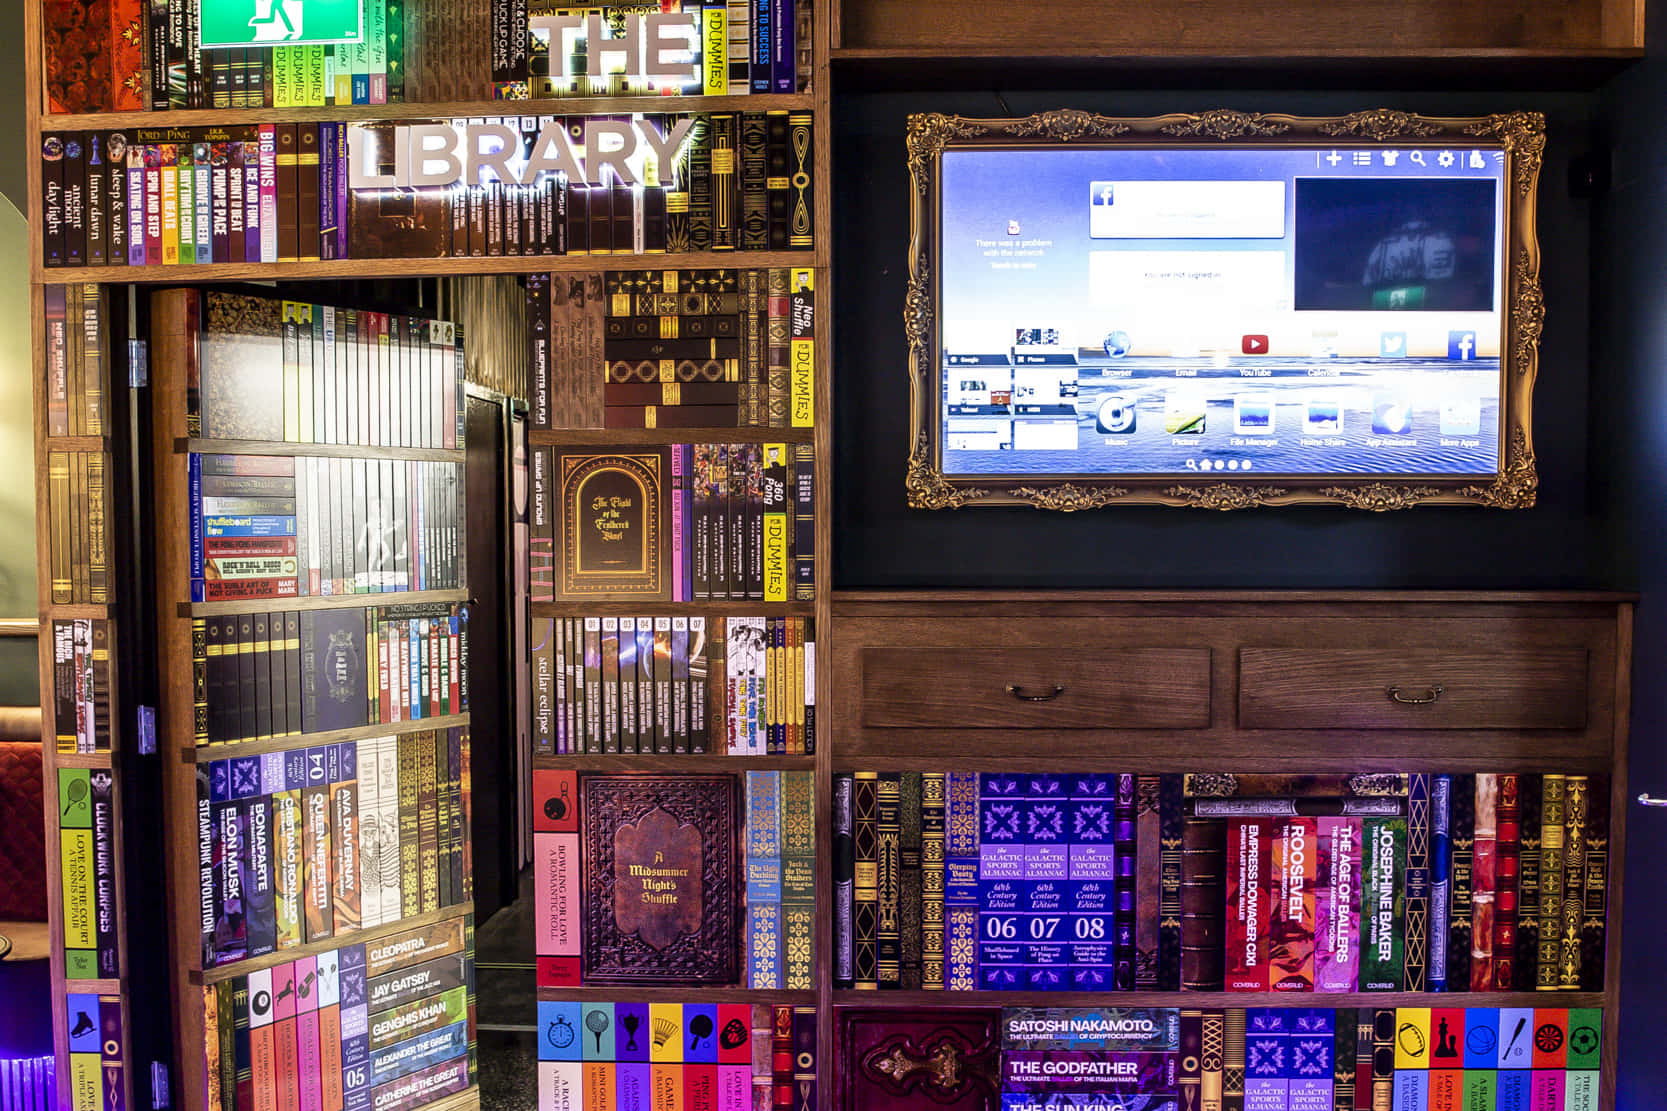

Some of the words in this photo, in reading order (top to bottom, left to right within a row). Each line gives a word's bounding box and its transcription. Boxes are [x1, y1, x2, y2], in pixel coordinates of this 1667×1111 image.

[760, 13, 769, 24] TO
[175, 26, 183, 49] LOVE
[529, 13, 697, 78] THE
[759, 26, 769, 65] SUCCESS
[193, 47, 201, 75] HEART
[708, 19, 723, 89] DUMMIES
[276, 51, 287, 104] DUMMIES
[293, 50, 304, 103] DUMMIES
[311, 49, 322, 103] DUMMIES
[260, 131, 275, 152] BIG
[348, 118, 697, 186] LIBRARY
[108, 168, 125, 199] sleep
[147, 171, 159, 193] SPIN
[213, 169, 227, 199] PUMP
[230, 167, 242, 200] SPRINT
[246, 167, 258, 182] ICE
[260, 155, 275, 187] WINS
[90, 174, 102, 205] lunar
[147, 194, 160, 213] AND
[247, 184, 259, 203] AND
[45, 181, 62, 236] daylight
[64, 190, 73, 224] moon
[72, 184, 84, 229] ancient
[112, 201, 124, 211] &
[247, 204, 259, 229] FUNK
[90, 207, 103, 241] dawn
[112, 214, 125, 245] wake
[148, 215, 160, 238] STEP
[213, 209, 227, 236] PACE
[793, 296, 805, 336] Shuffle
[803, 305, 813, 328] Neo
[795, 351, 811, 421] DUMMIES
[1239, 368, 1272, 377] YouTube
[763, 477, 774, 506] Pong
[774, 480, 784, 502] 360
[767, 526, 783, 595] DUMMIES
[693, 620, 702, 628] 07
[460, 632, 468, 666] midday
[461, 669, 469, 696] moon
[539, 656, 551, 692] stellar
[536, 694, 551, 734] eclipse
[309, 753, 324, 780] 04
[314, 793, 325, 840] QUEEN
[342, 789, 352, 816] AVA
[95, 802, 112, 876] CLOCKWORK
[199, 799, 211, 865] STEAMPUNK
[226, 807, 238, 850] ELON
[285, 797, 296, 865] CRISTIANO
[1340, 825, 1352, 851] THE
[69, 848, 77, 856] A
[76, 833, 86, 862] LOVE
[255, 803, 268, 892] BONAPARTE
[343, 817, 354, 890] DUVERNAY
[550, 849, 558, 857] A
[654, 850, 664, 865] A
[1247, 824, 1259, 880] EMPRESS
[69, 857, 79, 894] TENNIS
[77, 864, 87, 881] ON
[227, 851, 239, 900] MUSK
[317, 842, 327, 909] NEFERTITI
[558, 845, 567, 894] BOWLING
[629, 864, 689, 877] Midsummer
[982, 869, 1021, 877] ALMANAC
[1025, 869, 1065, 877] ALMANAC
[1071, 869, 1111, 877] ALMANAC
[1288, 825, 1305, 923] ROOSEVELT
[1330, 876, 1337, 886] OF
[1339, 853, 1351, 882] AGE
[1379, 825, 1394, 910] JOSEPHINE
[78, 883, 88, 904] THE
[287, 865, 298, 925] RONALDO
[549, 858, 559, 912] ROMANTIC
[641, 892, 679, 904] Shuffle
[642, 878, 677, 892] Night's
[987, 890, 1017, 899] Century
[1030, 890, 1060, 899] Century
[1075, 890, 1106, 899] Century
[1339, 883, 1350, 903] OF
[71, 895, 81, 929] AFFAIR
[98, 878, 113, 933] CORPSES
[201, 866, 215, 934] REVOLUTION
[559, 895, 567, 916] FOR
[988, 899, 1016, 909] Edition
[1031, 899, 1059, 909] Edition
[1076, 899, 1104, 909] Edition
[1246, 881, 1258, 942] DOWAGER
[79, 904, 90, 945] COURT
[550, 913, 559, 941] ROLL
[559, 918, 568, 946] LOVE
[987, 917, 1017, 939] 06
[1030, 917, 1061, 939] 07
[1075, 917, 1105, 939] 08
[1336, 904, 1350, 963] BALLERS
[1371, 915, 1378, 924] OF
[370, 937, 426, 962] CLEOPATRA
[1378, 911, 1392, 962] BAKER
[1245, 942, 1257, 967] CIXI
[371, 983, 390, 999] JAY
[391, 970, 430, 993] GATSBY
[372, 1011, 419, 1037] GENGHIS
[419, 1001, 447, 1021] KHAN
[1009, 1019, 1068, 1032] SATOSHI
[1070, 1019, 1153, 1032] NAKAMOTO
[374, 1045, 418, 1069] ALEXANDER
[416, 1040, 431, 1052] THE
[430, 1032, 453, 1047] GREAT
[346, 1067, 365, 1089] 05
[599, 1067, 607, 1086] MINI
[1010, 1061, 1041, 1074] THE
[1042, 1061, 1138, 1075] GODFATHER
[87, 1080, 96, 1108] LOVE
[374, 1084, 419, 1107] CATHERINE
[418, 1077, 435, 1090] THE
[433, 1067, 459, 1084] GREAT
[701, 1075, 710, 1100] PING
[734, 1071, 742, 1094] LOVE
[1445, 1074, 1453, 1101] LOVE
